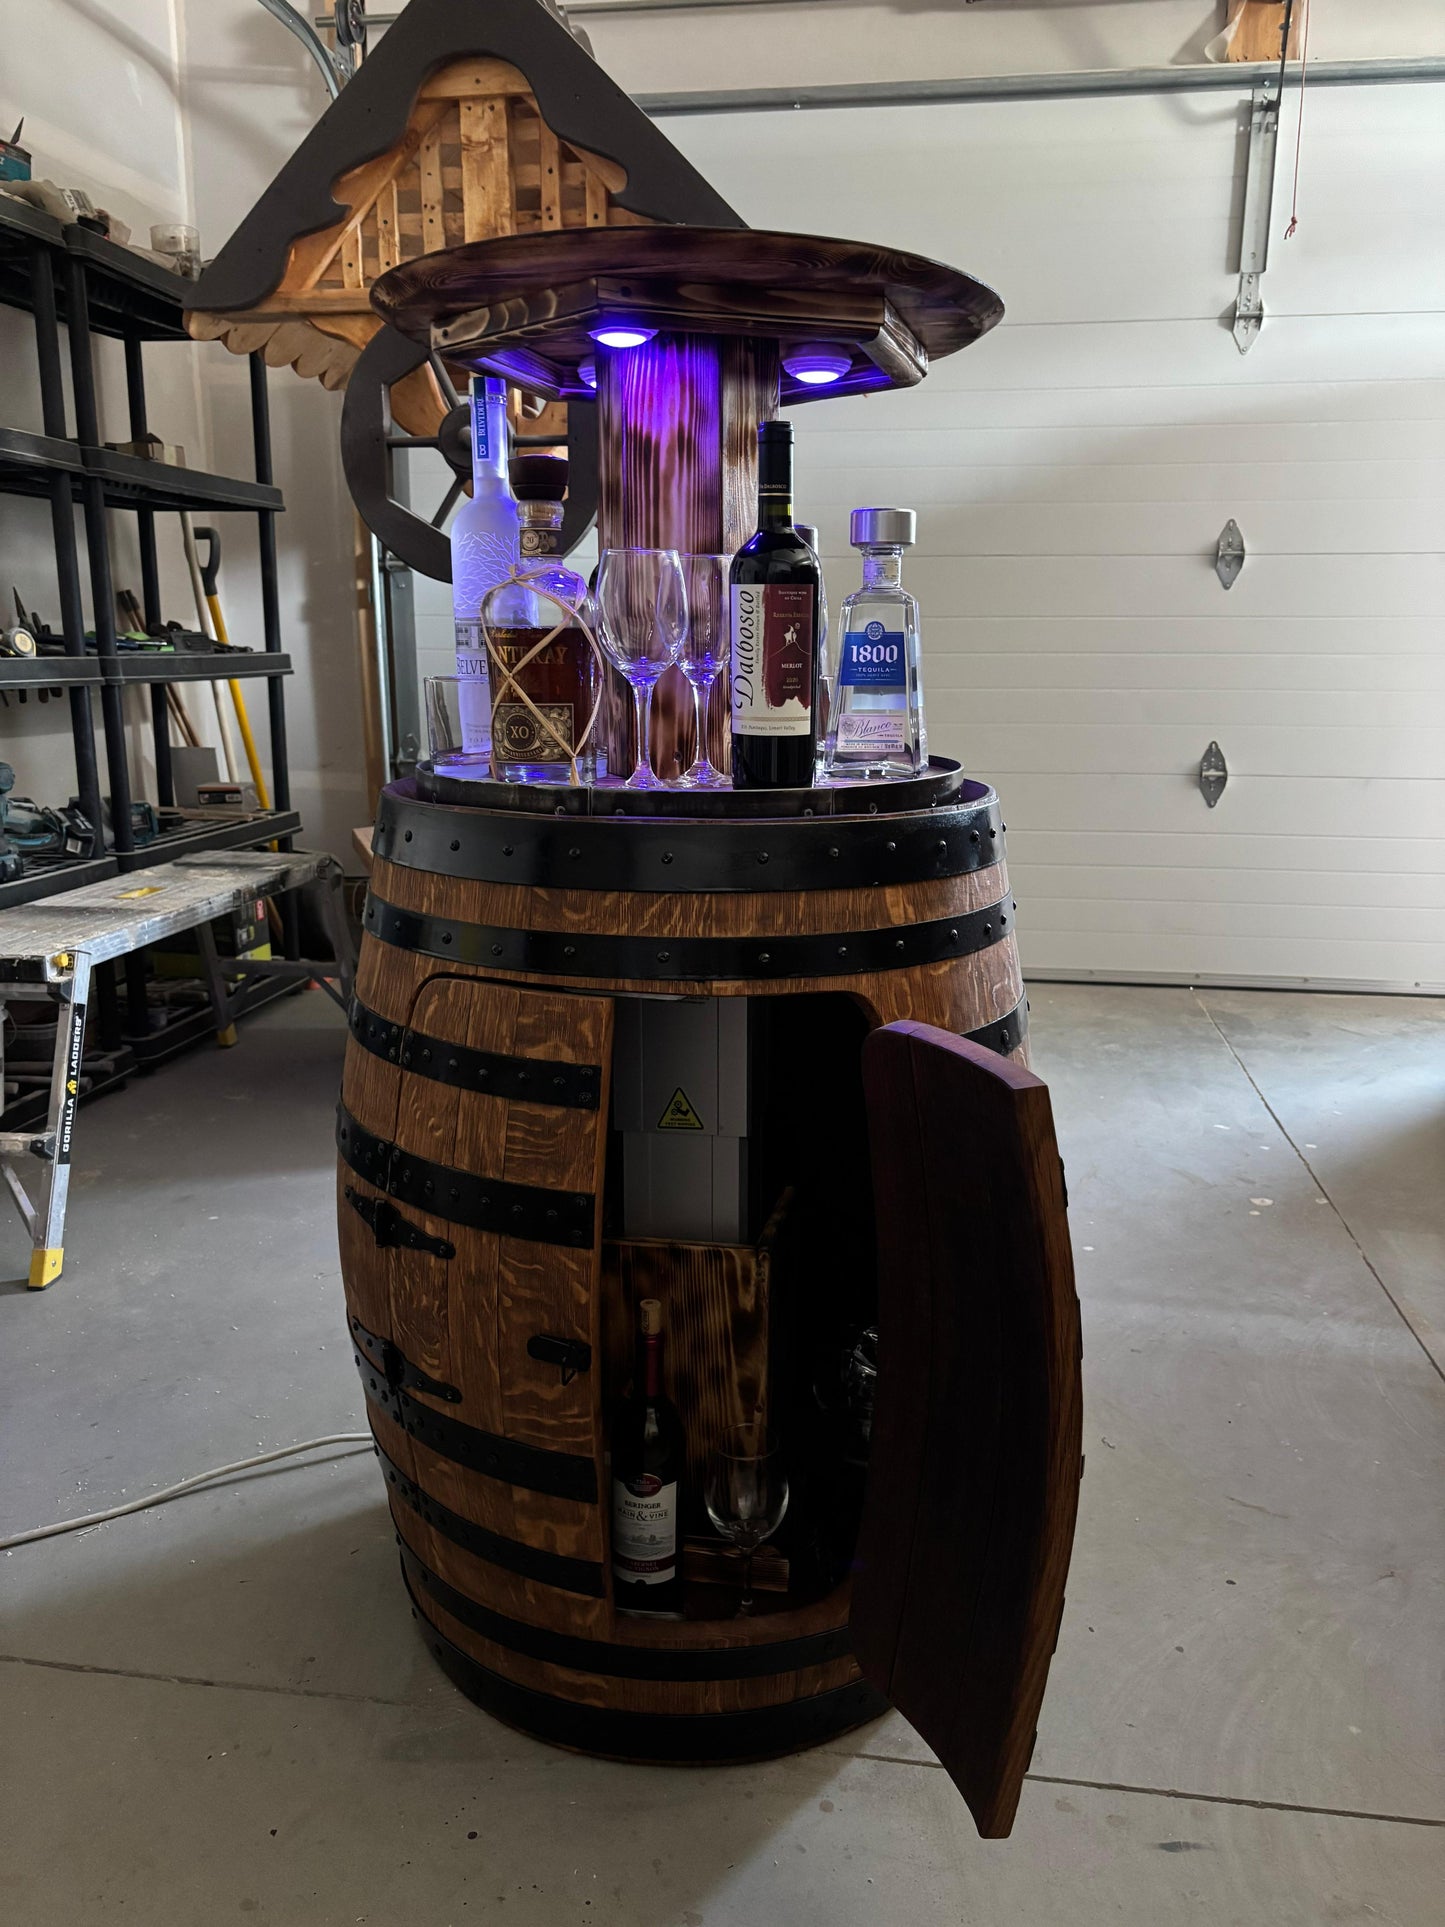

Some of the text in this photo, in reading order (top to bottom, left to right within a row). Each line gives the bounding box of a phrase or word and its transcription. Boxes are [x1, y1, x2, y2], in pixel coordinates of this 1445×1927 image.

[476, 398, 487, 436] BELVEDERE
[490, 645, 569, 665] NTERAY
[733, 590, 755, 710] Dalbosco
[850, 644, 898, 663] 1800
[510, 725, 529, 739] XO
[853, 718, 892, 739] Blanco
[62, 1018, 82, 1153] GORILLA LADDERS
[624, 1500, 661, 1509] BERINGER
